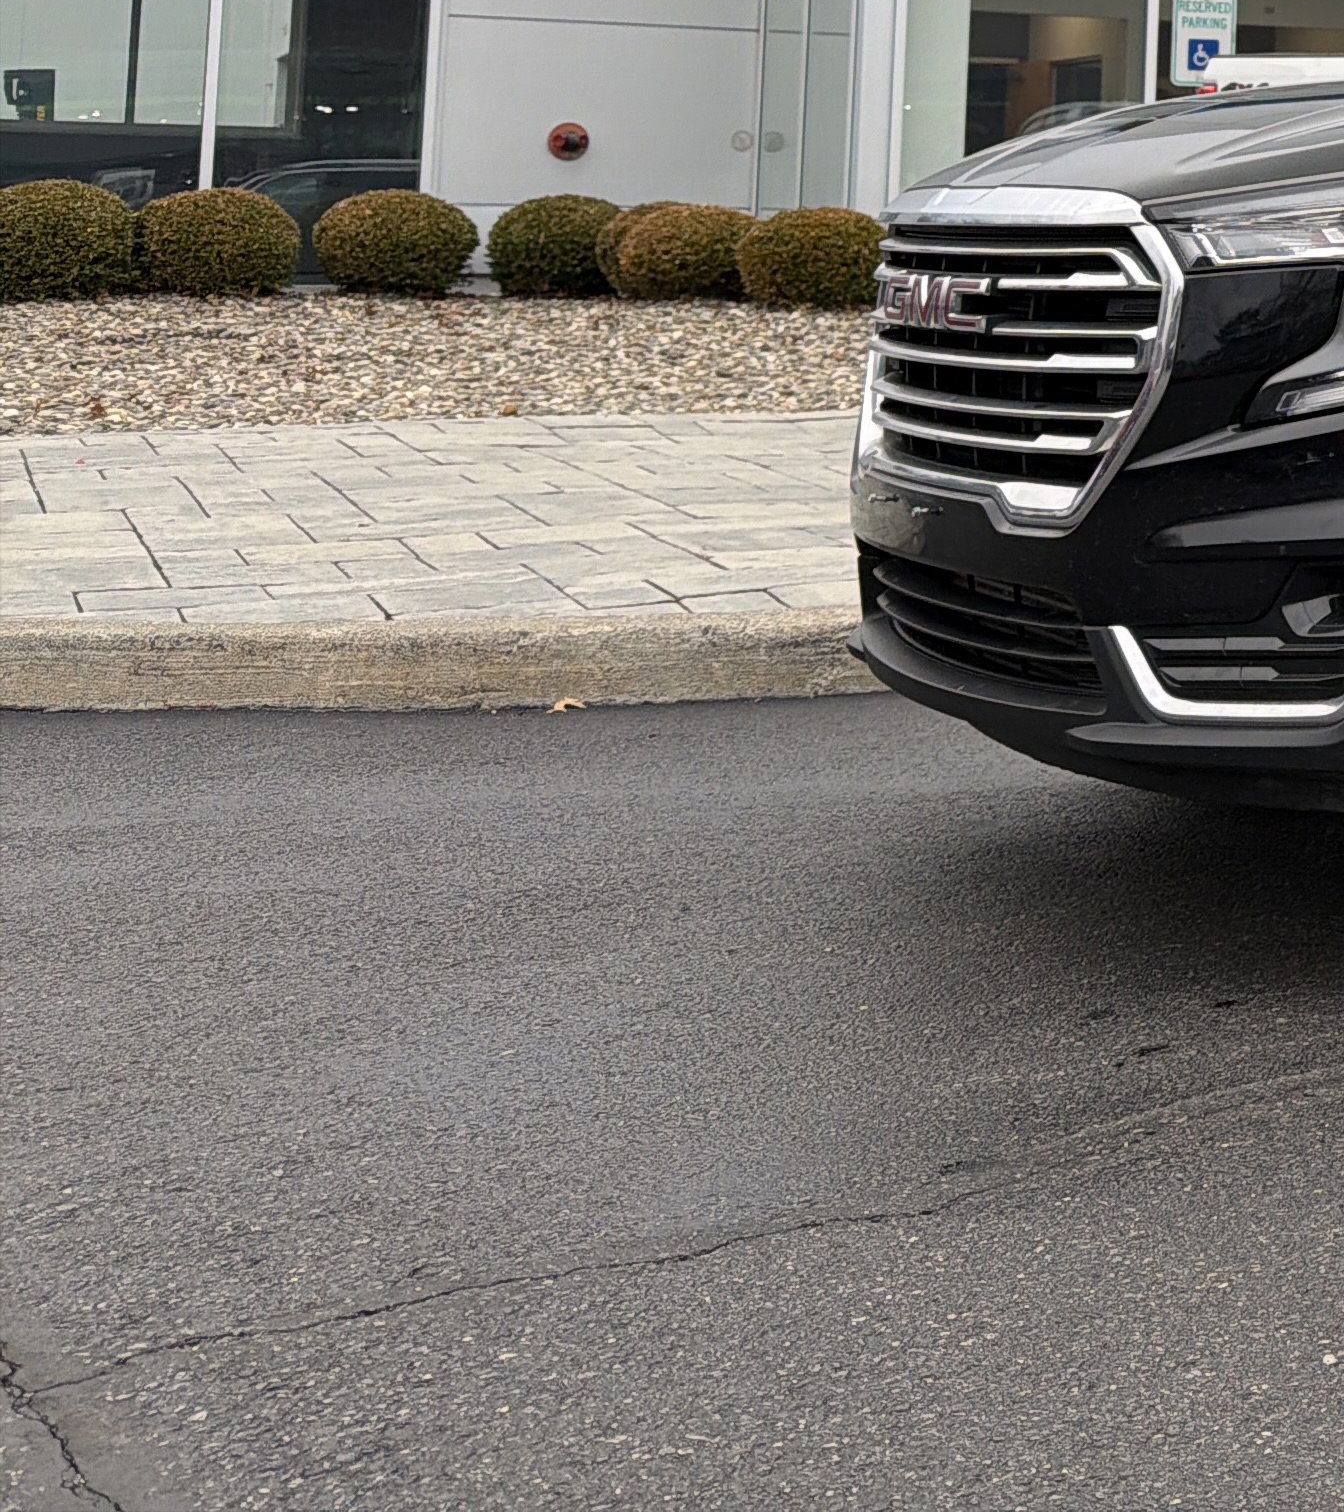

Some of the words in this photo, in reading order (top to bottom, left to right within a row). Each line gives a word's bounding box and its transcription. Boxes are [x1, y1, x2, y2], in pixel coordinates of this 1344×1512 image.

[1179, 0, 1233, 14] RESERVED
[1182, 16, 1228, 30] PARKING
[884, 274, 990, 334] GMC
